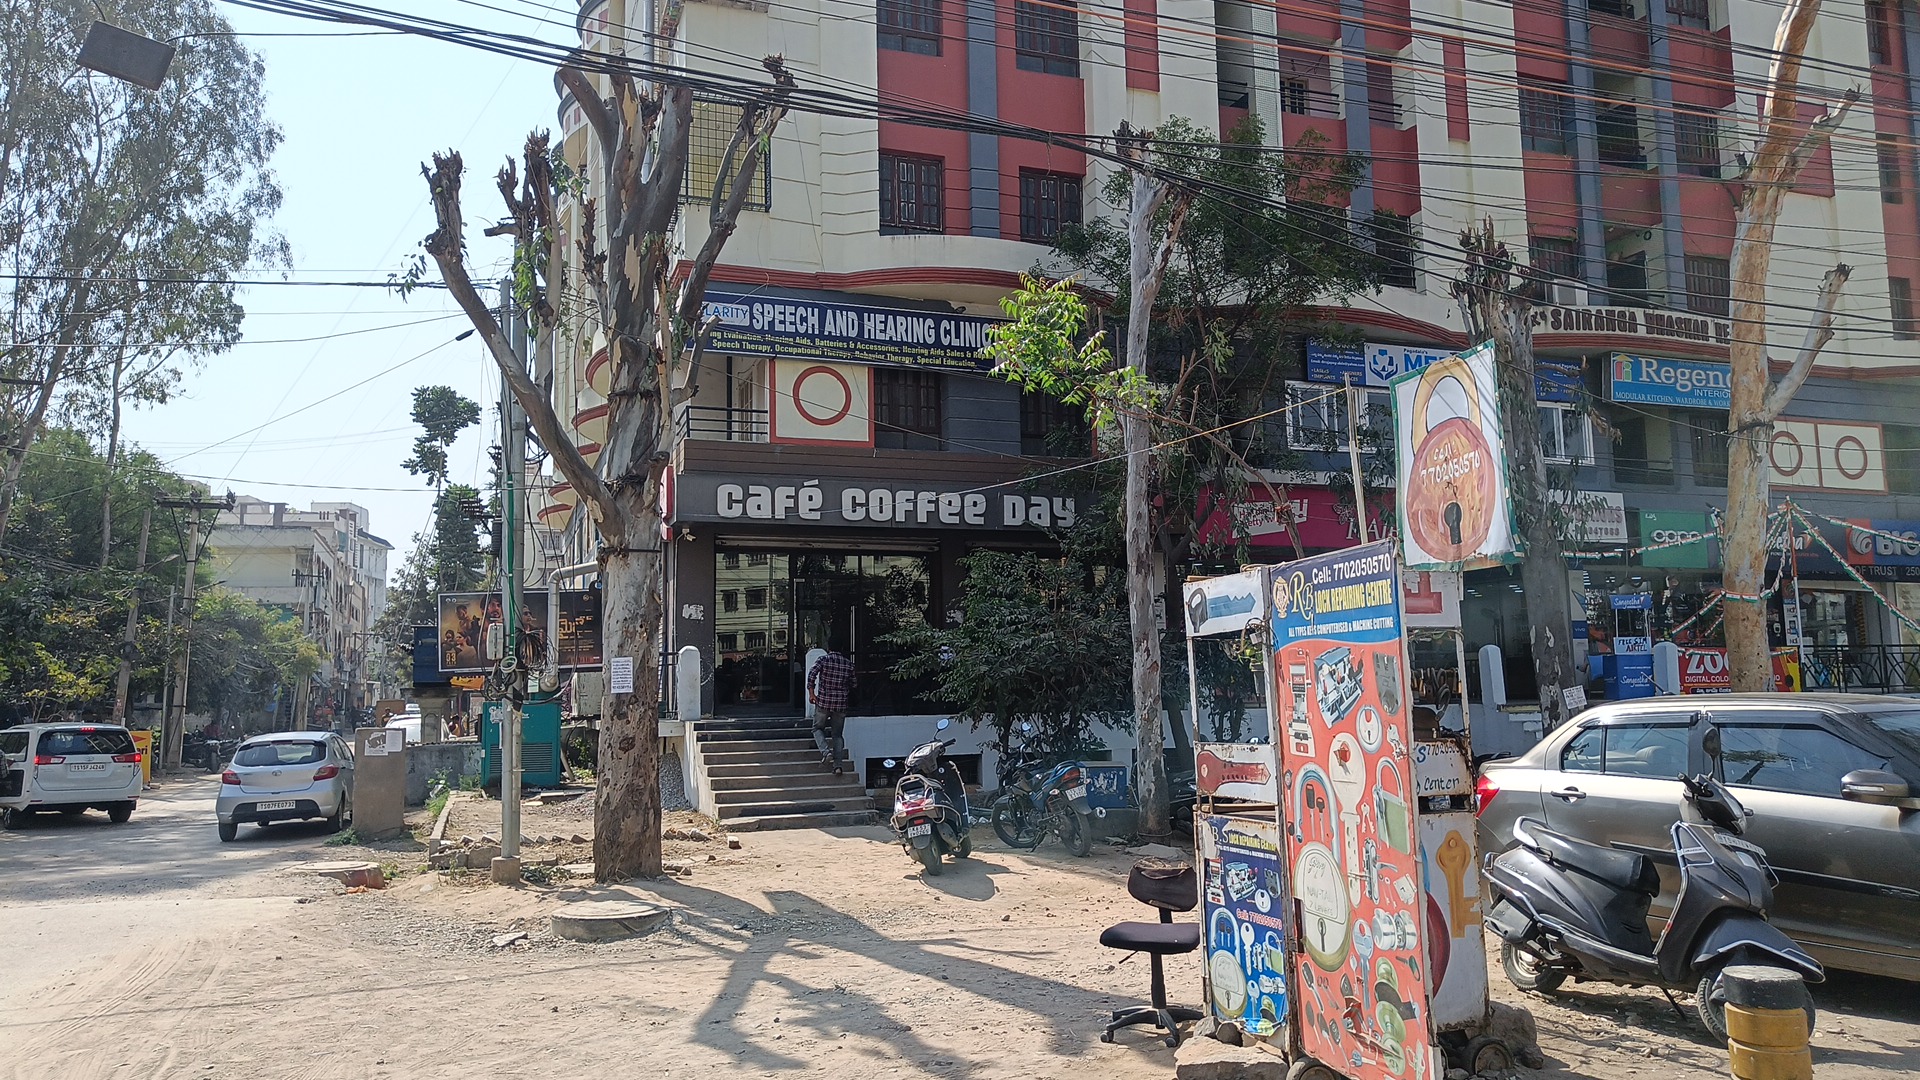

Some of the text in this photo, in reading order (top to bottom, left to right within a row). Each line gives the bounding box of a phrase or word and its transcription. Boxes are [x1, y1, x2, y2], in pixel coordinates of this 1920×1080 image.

[702, 305, 749, 318] LARITY
[1551, 308, 1638, 333] SAIRANGA
[752, 302, 992, 348] SPEECH AND HEARING CLINIC
[712, 339, 740, 349] Speech
[775, 345, 822, 355] Occupational
[917, 356, 942, 366] Special
[815, 339, 847, 349] Batteries
[903, 346, 929, 356] Hearing
[930, 348, 944, 357] Aids
[947, 349, 965, 359] Sales
[1616, 392, 1645, 401] MODULAR
[1676, 397, 1707, 406] WARDROBE
[1421, 450, 1480, 486] 7702050570
[1312, 553, 1391, 584] Cell: 7702050570
[1869, 566, 1897, 576] TRUST
[1314, 579, 1392, 614] LOCK REPAIRING CENTRE
[1295, 626, 1306, 637] TYPES
[1317, 622, 1348, 635] COMPUTERISED
[1352, 619, 1373, 631] MACHINE
[1373, 616, 1394, 629] CUTTING
[1685, 675, 1710, 683] DIGITAL
